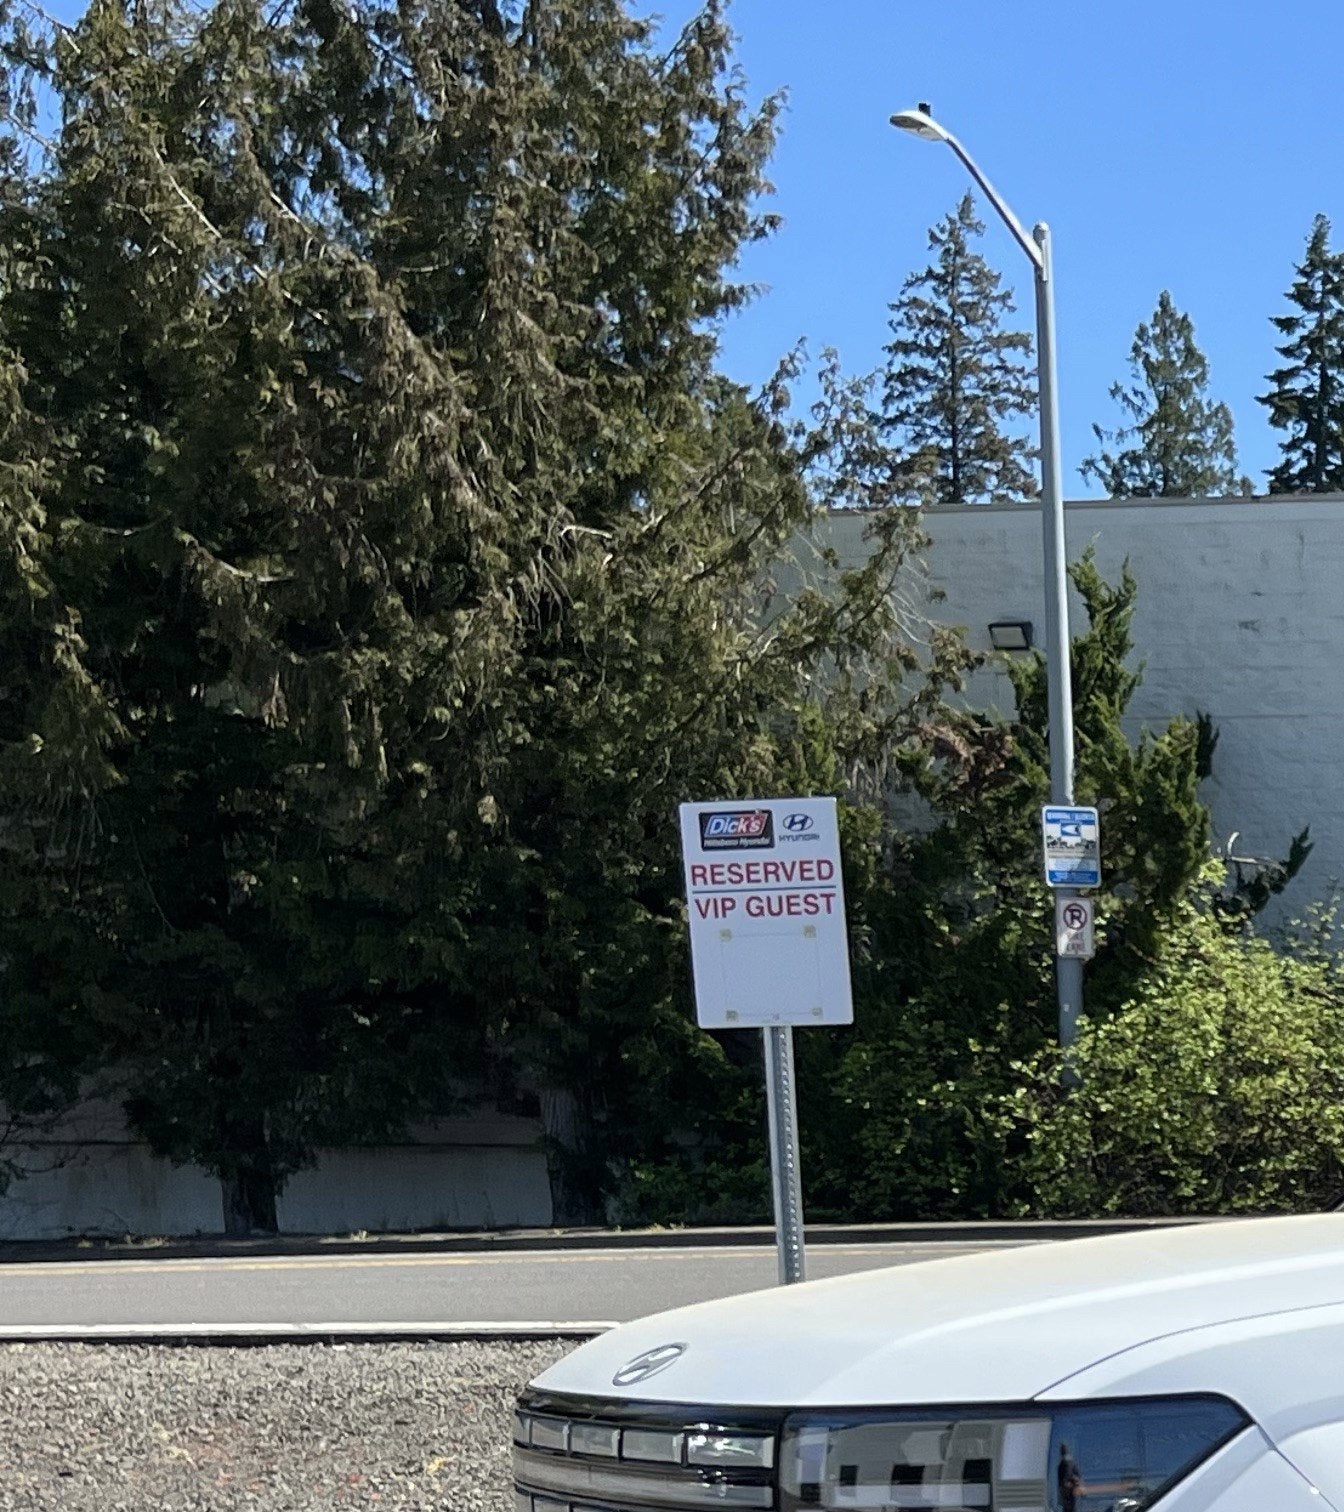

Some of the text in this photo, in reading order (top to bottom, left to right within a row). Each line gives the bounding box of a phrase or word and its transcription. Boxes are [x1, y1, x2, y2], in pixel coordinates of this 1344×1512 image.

[691, 860, 834, 886] RESERVED
[695, 893, 836, 919] VIP GUEST
